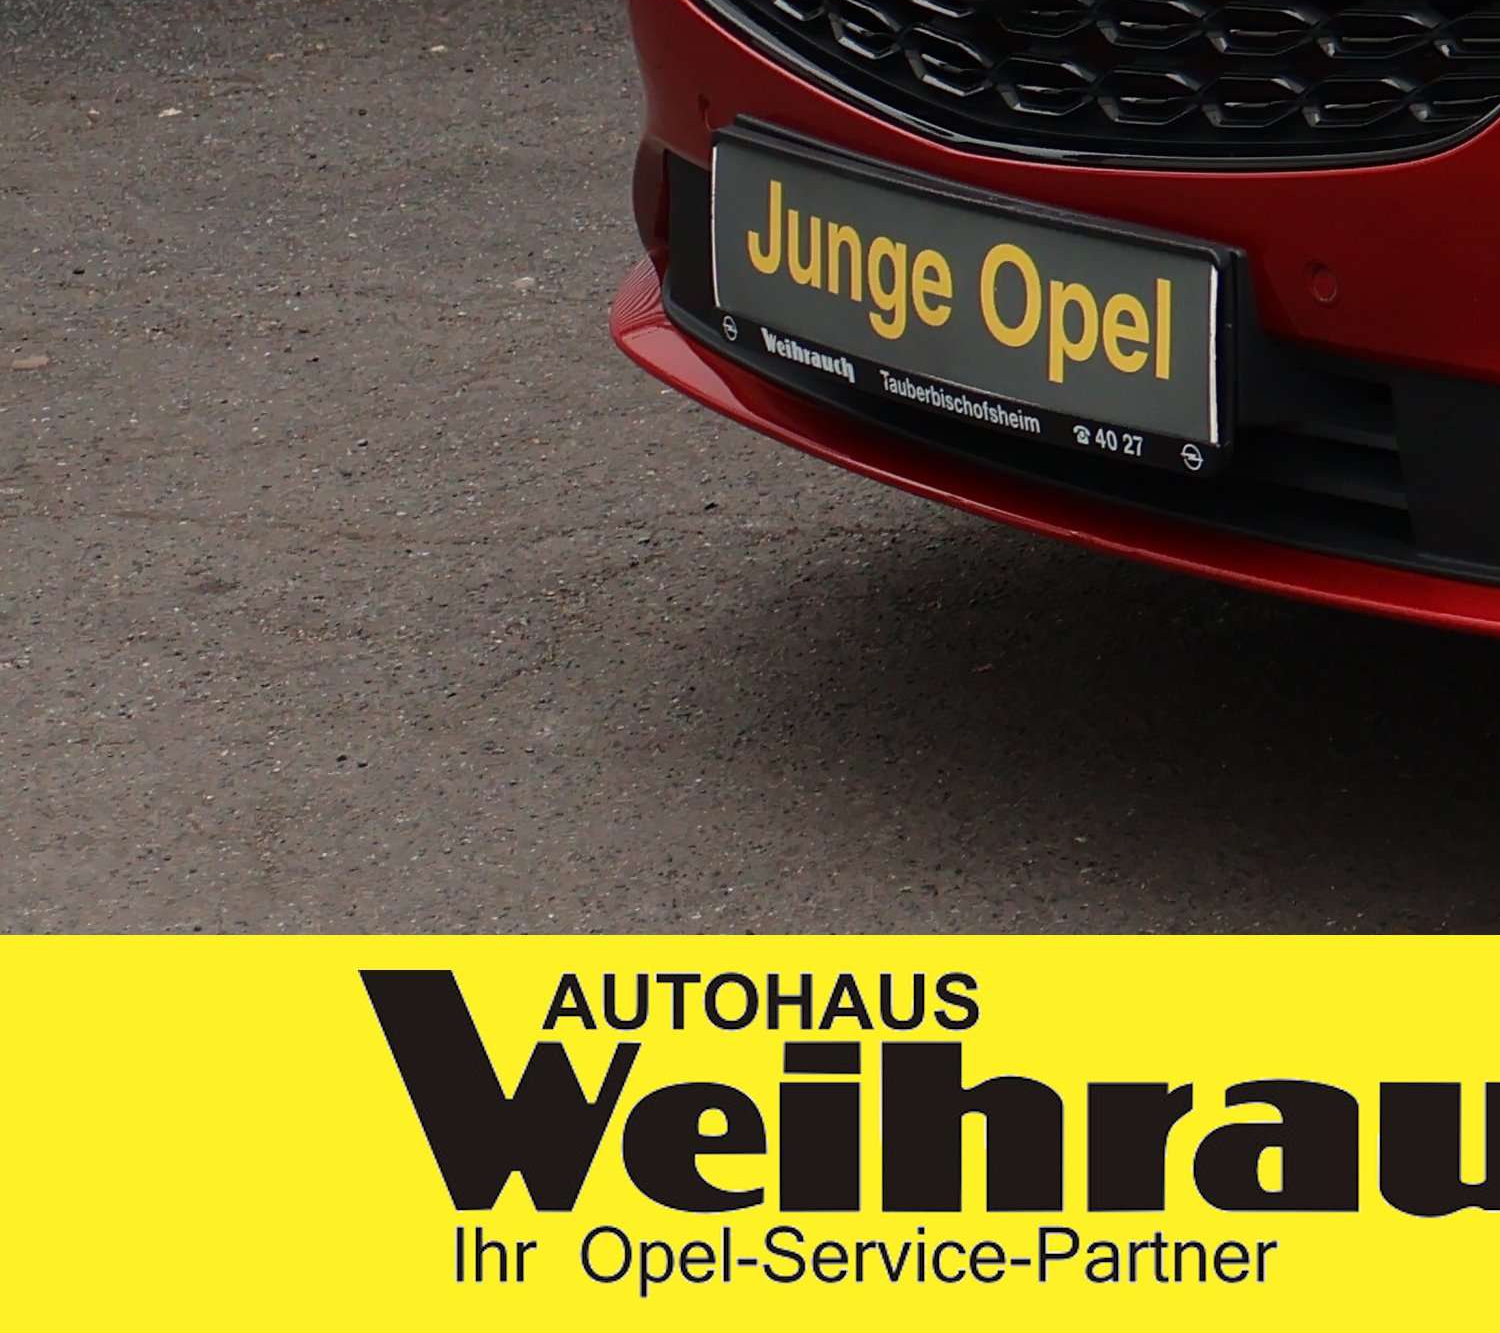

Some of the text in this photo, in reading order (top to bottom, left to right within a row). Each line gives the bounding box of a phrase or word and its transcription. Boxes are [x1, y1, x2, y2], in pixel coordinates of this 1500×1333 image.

[747, 179, 1173, 385] Junge Opel
[760, 327, 1144, 457] Weihrauch Tauberbischofsheim 40 27
